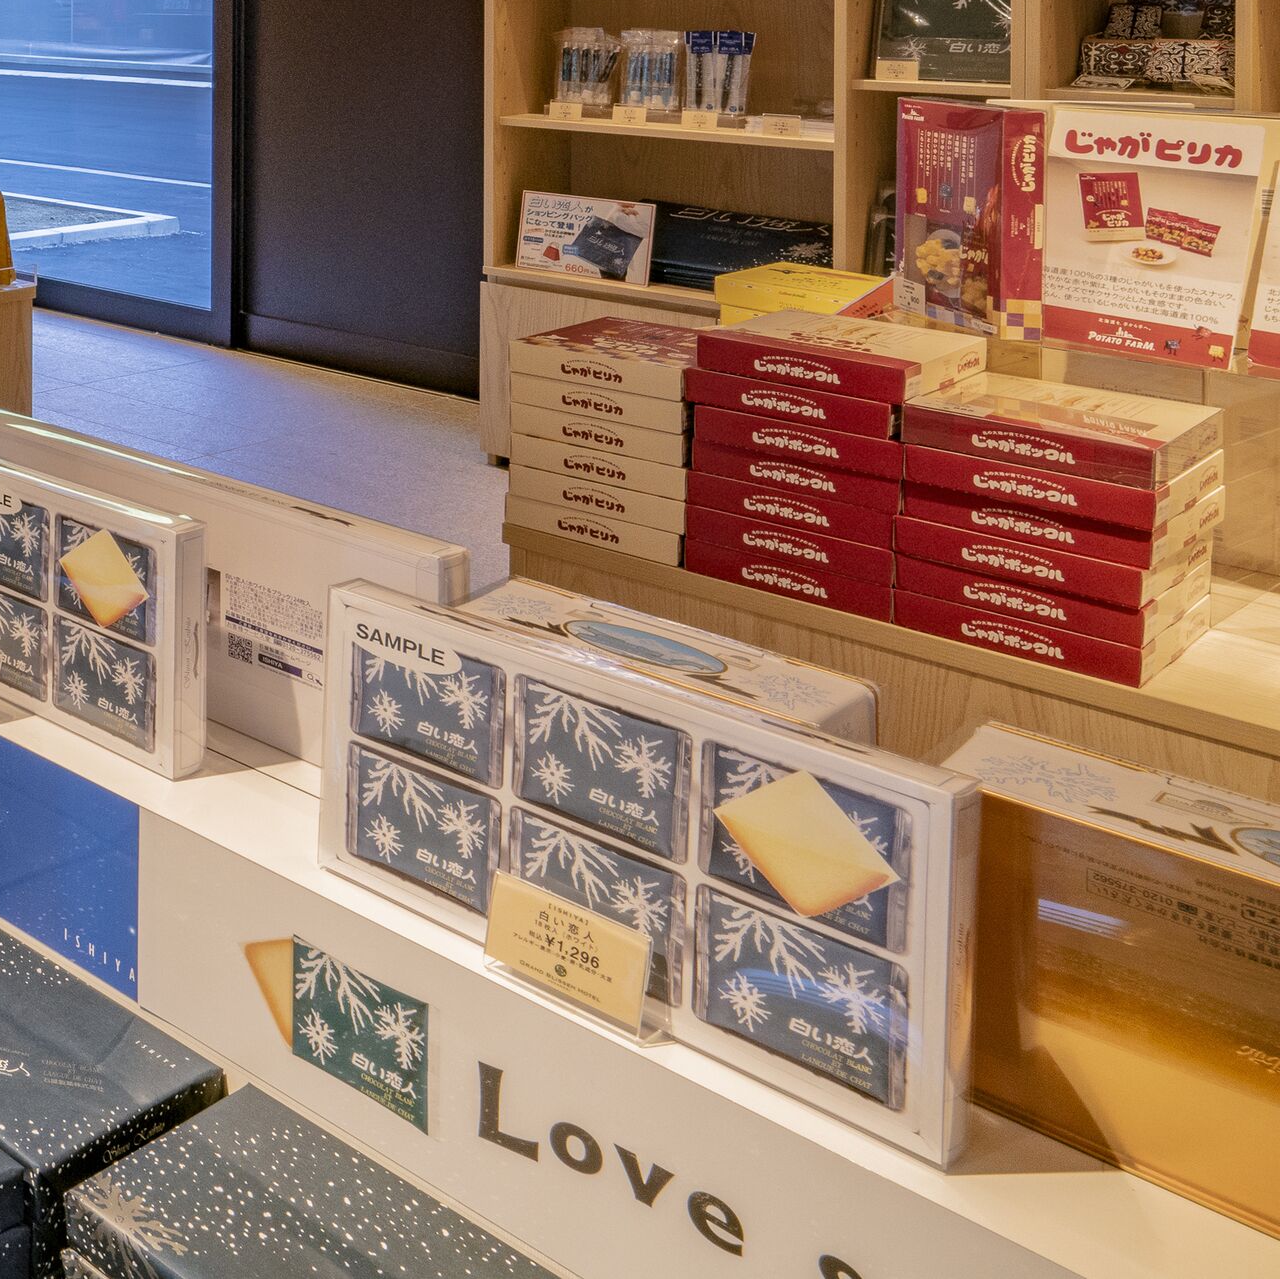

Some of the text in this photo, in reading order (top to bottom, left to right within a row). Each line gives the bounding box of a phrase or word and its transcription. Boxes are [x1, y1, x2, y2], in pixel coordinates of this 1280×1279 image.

[1065, 129, 1243, 168] じゃがピリカ
[1088, 331, 1122, 345] POTATO
[561, 363, 622, 384] じゃがピリカ
[754, 359, 840, 385] じゃがポックル
[562, 394, 623, 416] じゃがピリカ
[741, 393, 826, 420] じゃがポックル
[562, 426, 624, 447] じゃがピリカ
[752, 431, 839, 459] じゃがポックル
[971, 434, 1076, 465] じゃがポックル
[564, 458, 626, 480] じゃがピリカ
[750, 464, 836, 493] じゃがポックル
[563, 490, 625, 513] じゃがピリカ
[973, 474, 1078, 506] じゃがポックル
[744, 498, 829, 527] じゃがポックル
[971, 511, 1075, 544] じゃがポックル
[557, 519, 619, 544] じゃがピリカ
[743, 532, 829, 563] じゃがポックル
[961, 548, 1065, 582] じゃがポックル
[742, 567, 828, 598] じゃがポックル
[963, 585, 1067, 621] じゃがポックル
[356, 624, 445, 666] SAMPLE
[961, 622, 1064, 660] じゃがポックル
[263, 656, 284, 670] ISHIYA
[97, 696, 138, 725] 白い恋人
[417, 721, 479, 754] 白い恋人
[589, 787, 659, 825] 白い恋人
[416, 848, 476, 884] 白い恋人
[1092, 872, 1174, 907] 0120-375562
[539, 911, 594, 943] 白い恋人
[64, 928, 135, 982] ISHIYA
[545, 934, 600, 968] ¥1,296
[578, 985, 601, 1003] HOTEL
[135, 1039, 176, 1069] ISHIYA
[790, 1018, 874, 1066] 白い恋人
[802, 1039, 872, 1075] CHOCOLAT BLANC
[352, 1052, 417, 1099] 白い恋人
[801, 1054, 832, 1075] LANGUE
[849, 1075, 872, 1090] CHAT
[478, 1060, 744, 1257] Love
